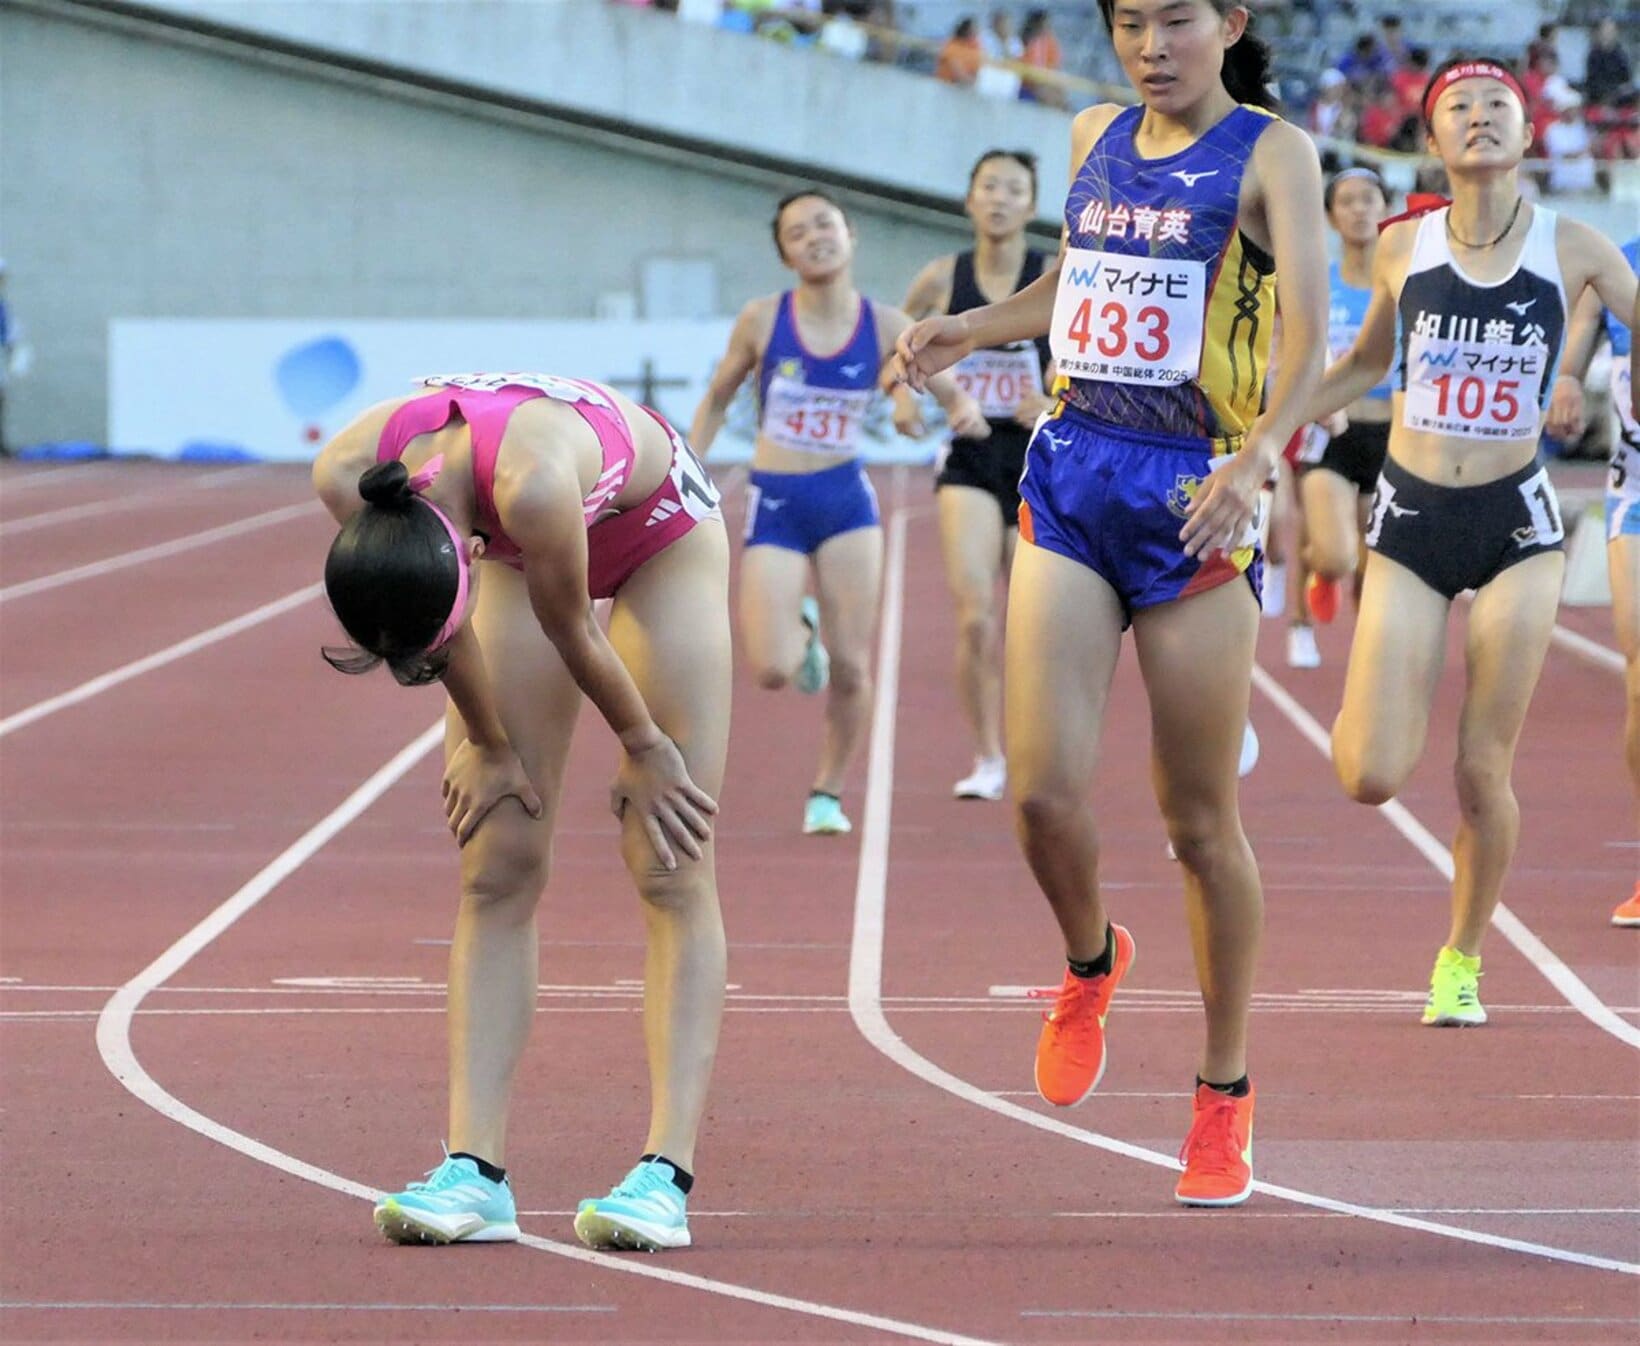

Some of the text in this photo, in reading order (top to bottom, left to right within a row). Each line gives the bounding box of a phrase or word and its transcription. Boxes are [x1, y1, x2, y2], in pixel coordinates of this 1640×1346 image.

[1078, 200, 1191, 244] 仙台育英
[1104, 267, 1189, 299] マイナビ
[1068, 298, 1170, 362] 433
[1112, 366, 1154, 380] 中国総体
[1158, 368, 1188, 382] 2025
[1463, 352, 1537, 375] マイナビ
[1432, 373, 1519, 423] 105
[786, 409, 848, 440] 431
